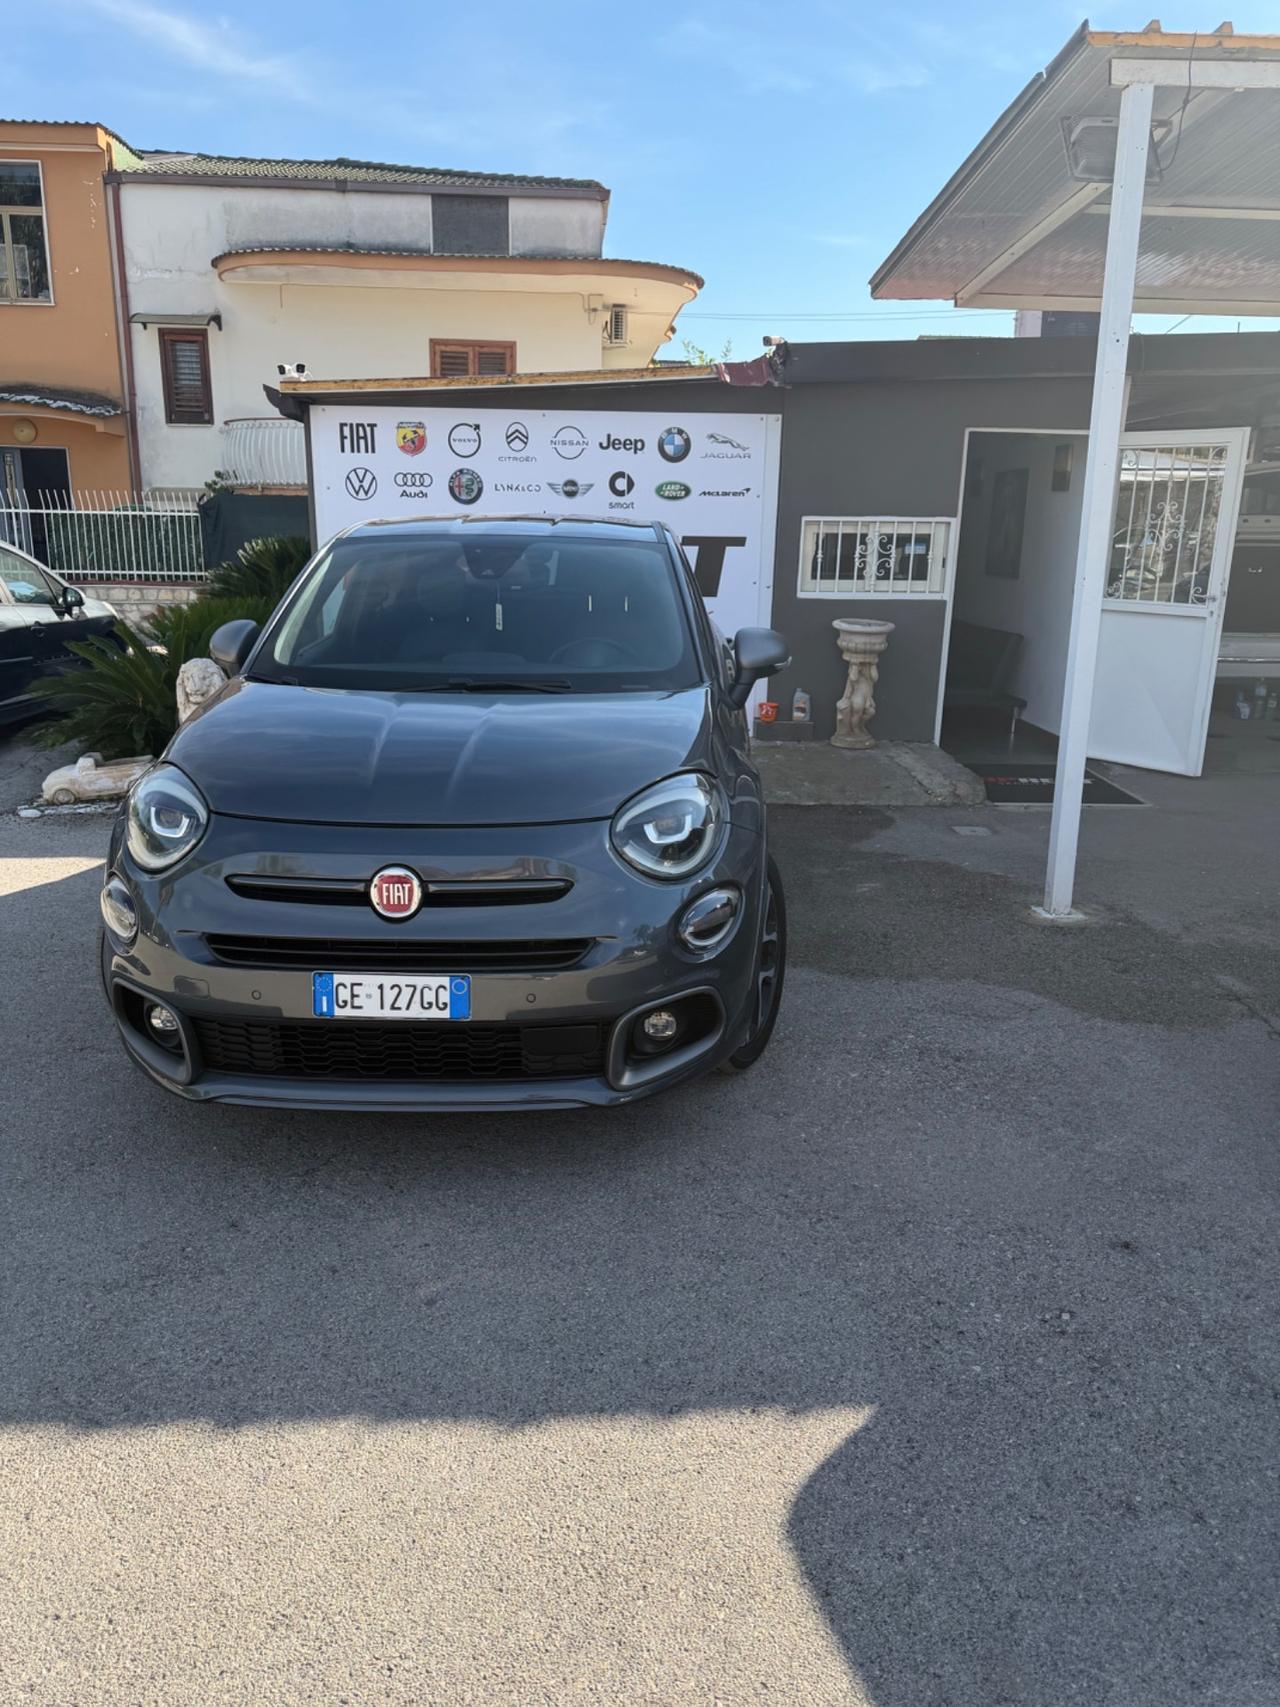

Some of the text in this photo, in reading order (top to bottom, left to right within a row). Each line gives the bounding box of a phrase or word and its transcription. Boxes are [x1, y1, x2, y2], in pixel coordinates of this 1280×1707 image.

[339, 422, 377, 453] FIAT
[550, 439, 589, 447] NISSAN
[599, 434, 645, 454] Jeep
[400, 490, 428, 498] Audi
[608, 501, 634, 509] smart
[382, 883, 411, 905] FIAT
[335, 982, 363, 1009] GE
[377, 983, 448, 1011] 127GG
